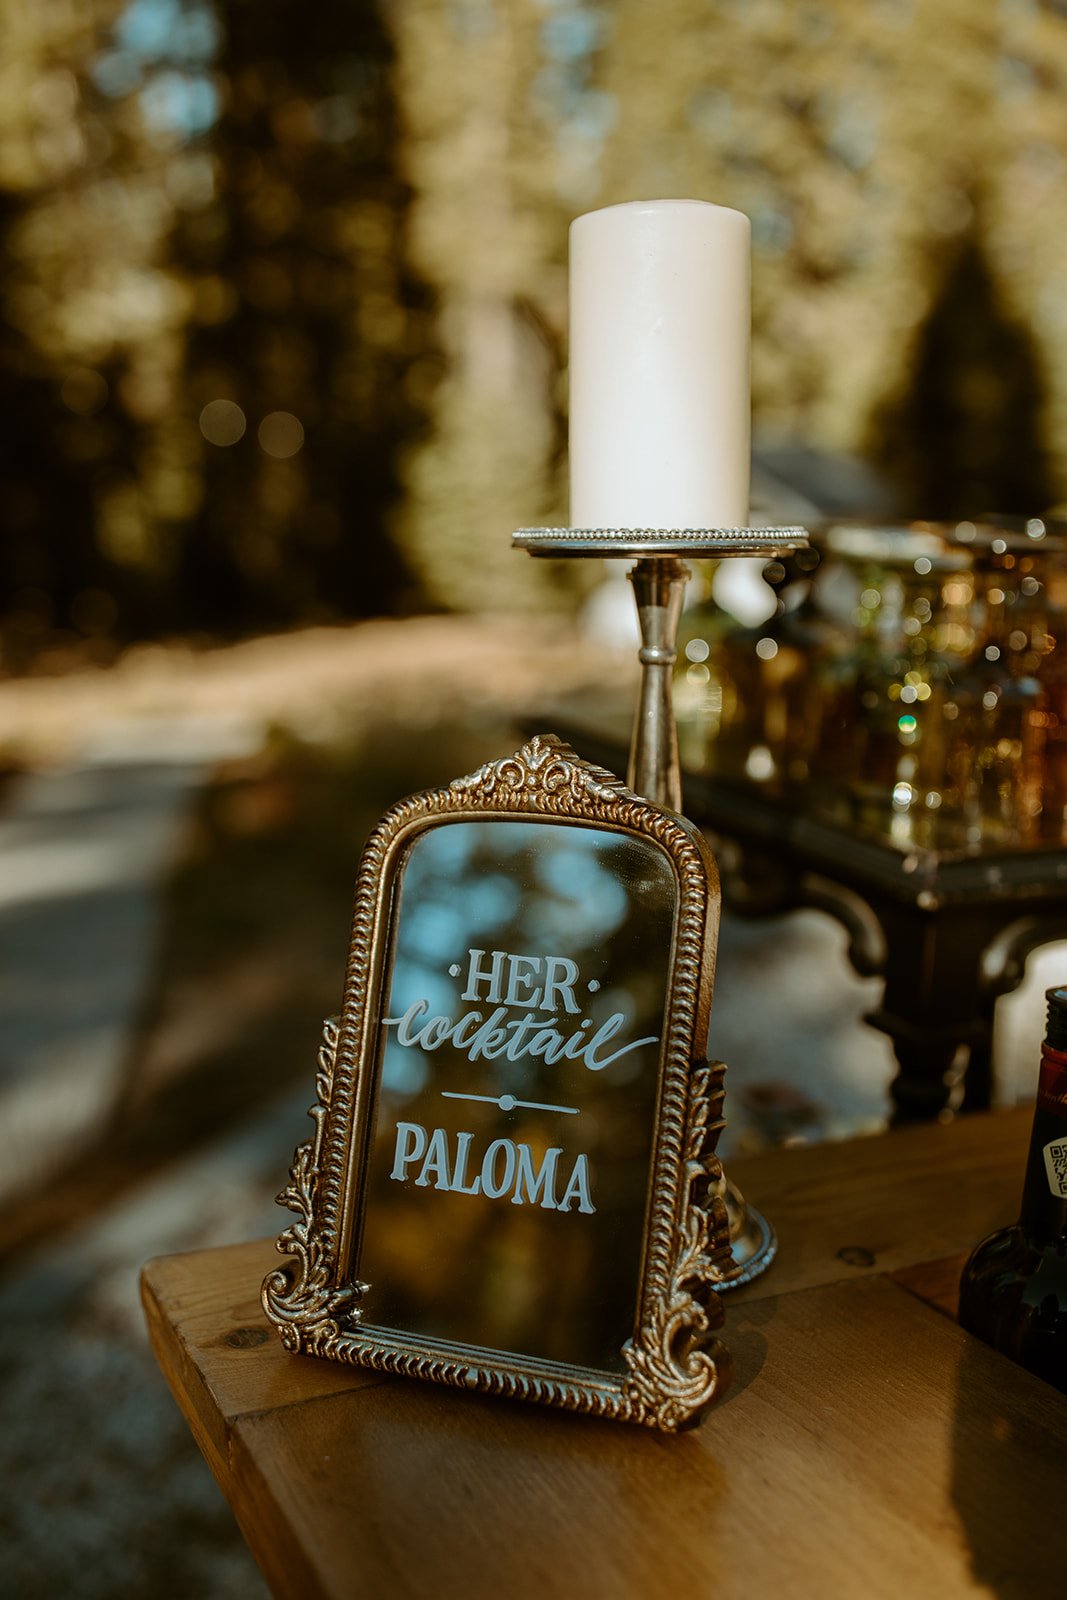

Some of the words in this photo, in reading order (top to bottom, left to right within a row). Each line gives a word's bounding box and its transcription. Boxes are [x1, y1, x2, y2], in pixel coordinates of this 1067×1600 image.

[461, 949, 581, 1013] HER
[382, 1000, 659, 1070] Cocktail
[390, 1122, 596, 1214] PALOMA
